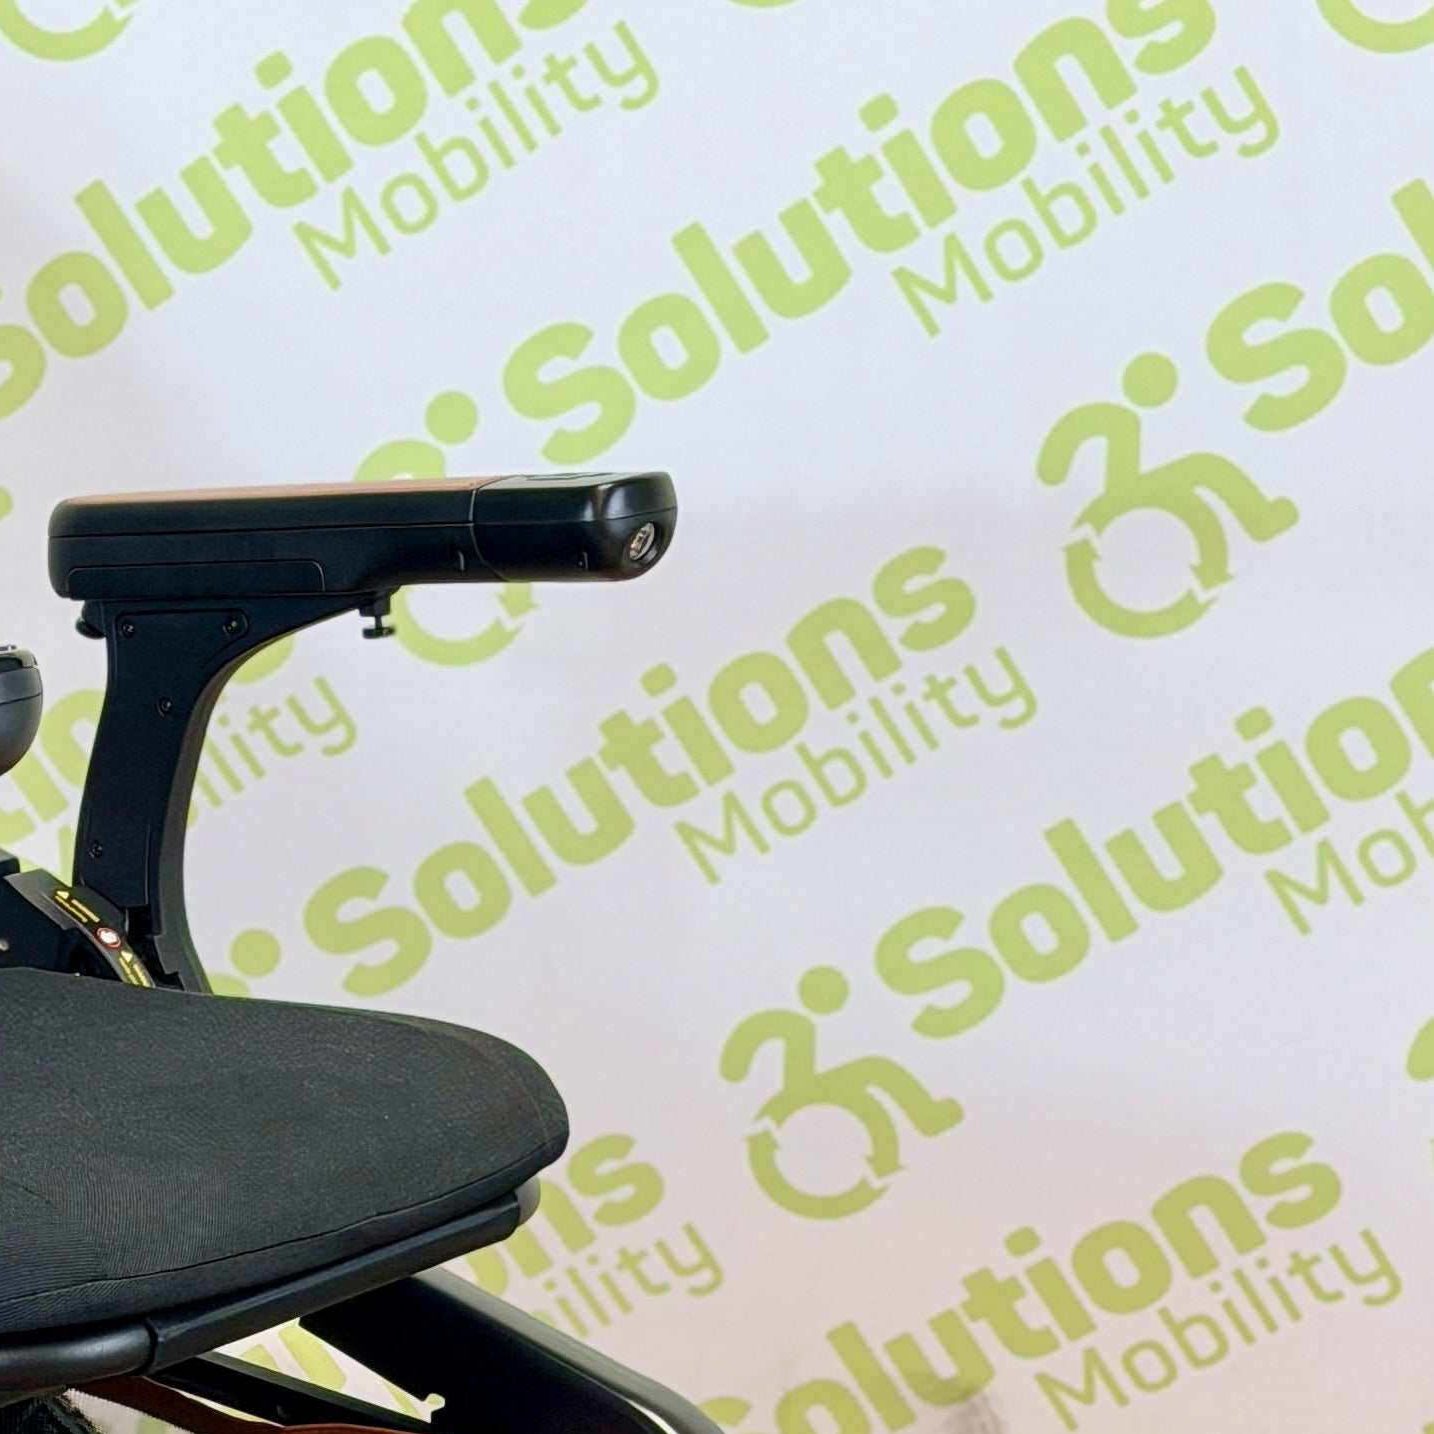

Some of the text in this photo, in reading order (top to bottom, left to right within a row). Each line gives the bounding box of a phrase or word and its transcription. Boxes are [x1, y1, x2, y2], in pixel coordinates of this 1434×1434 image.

[292, 21, 658, 291] Mobility
[504, 0, 1216, 465] Solutions
[891, 66, 1279, 337] Mobility
[303, 546, 976, 998] Solutions
[674, 646, 1038, 886] Mobility
[874, 647, 1434, 1039] Solutio
[1033, 1229, 1402, 1433] Mobility
